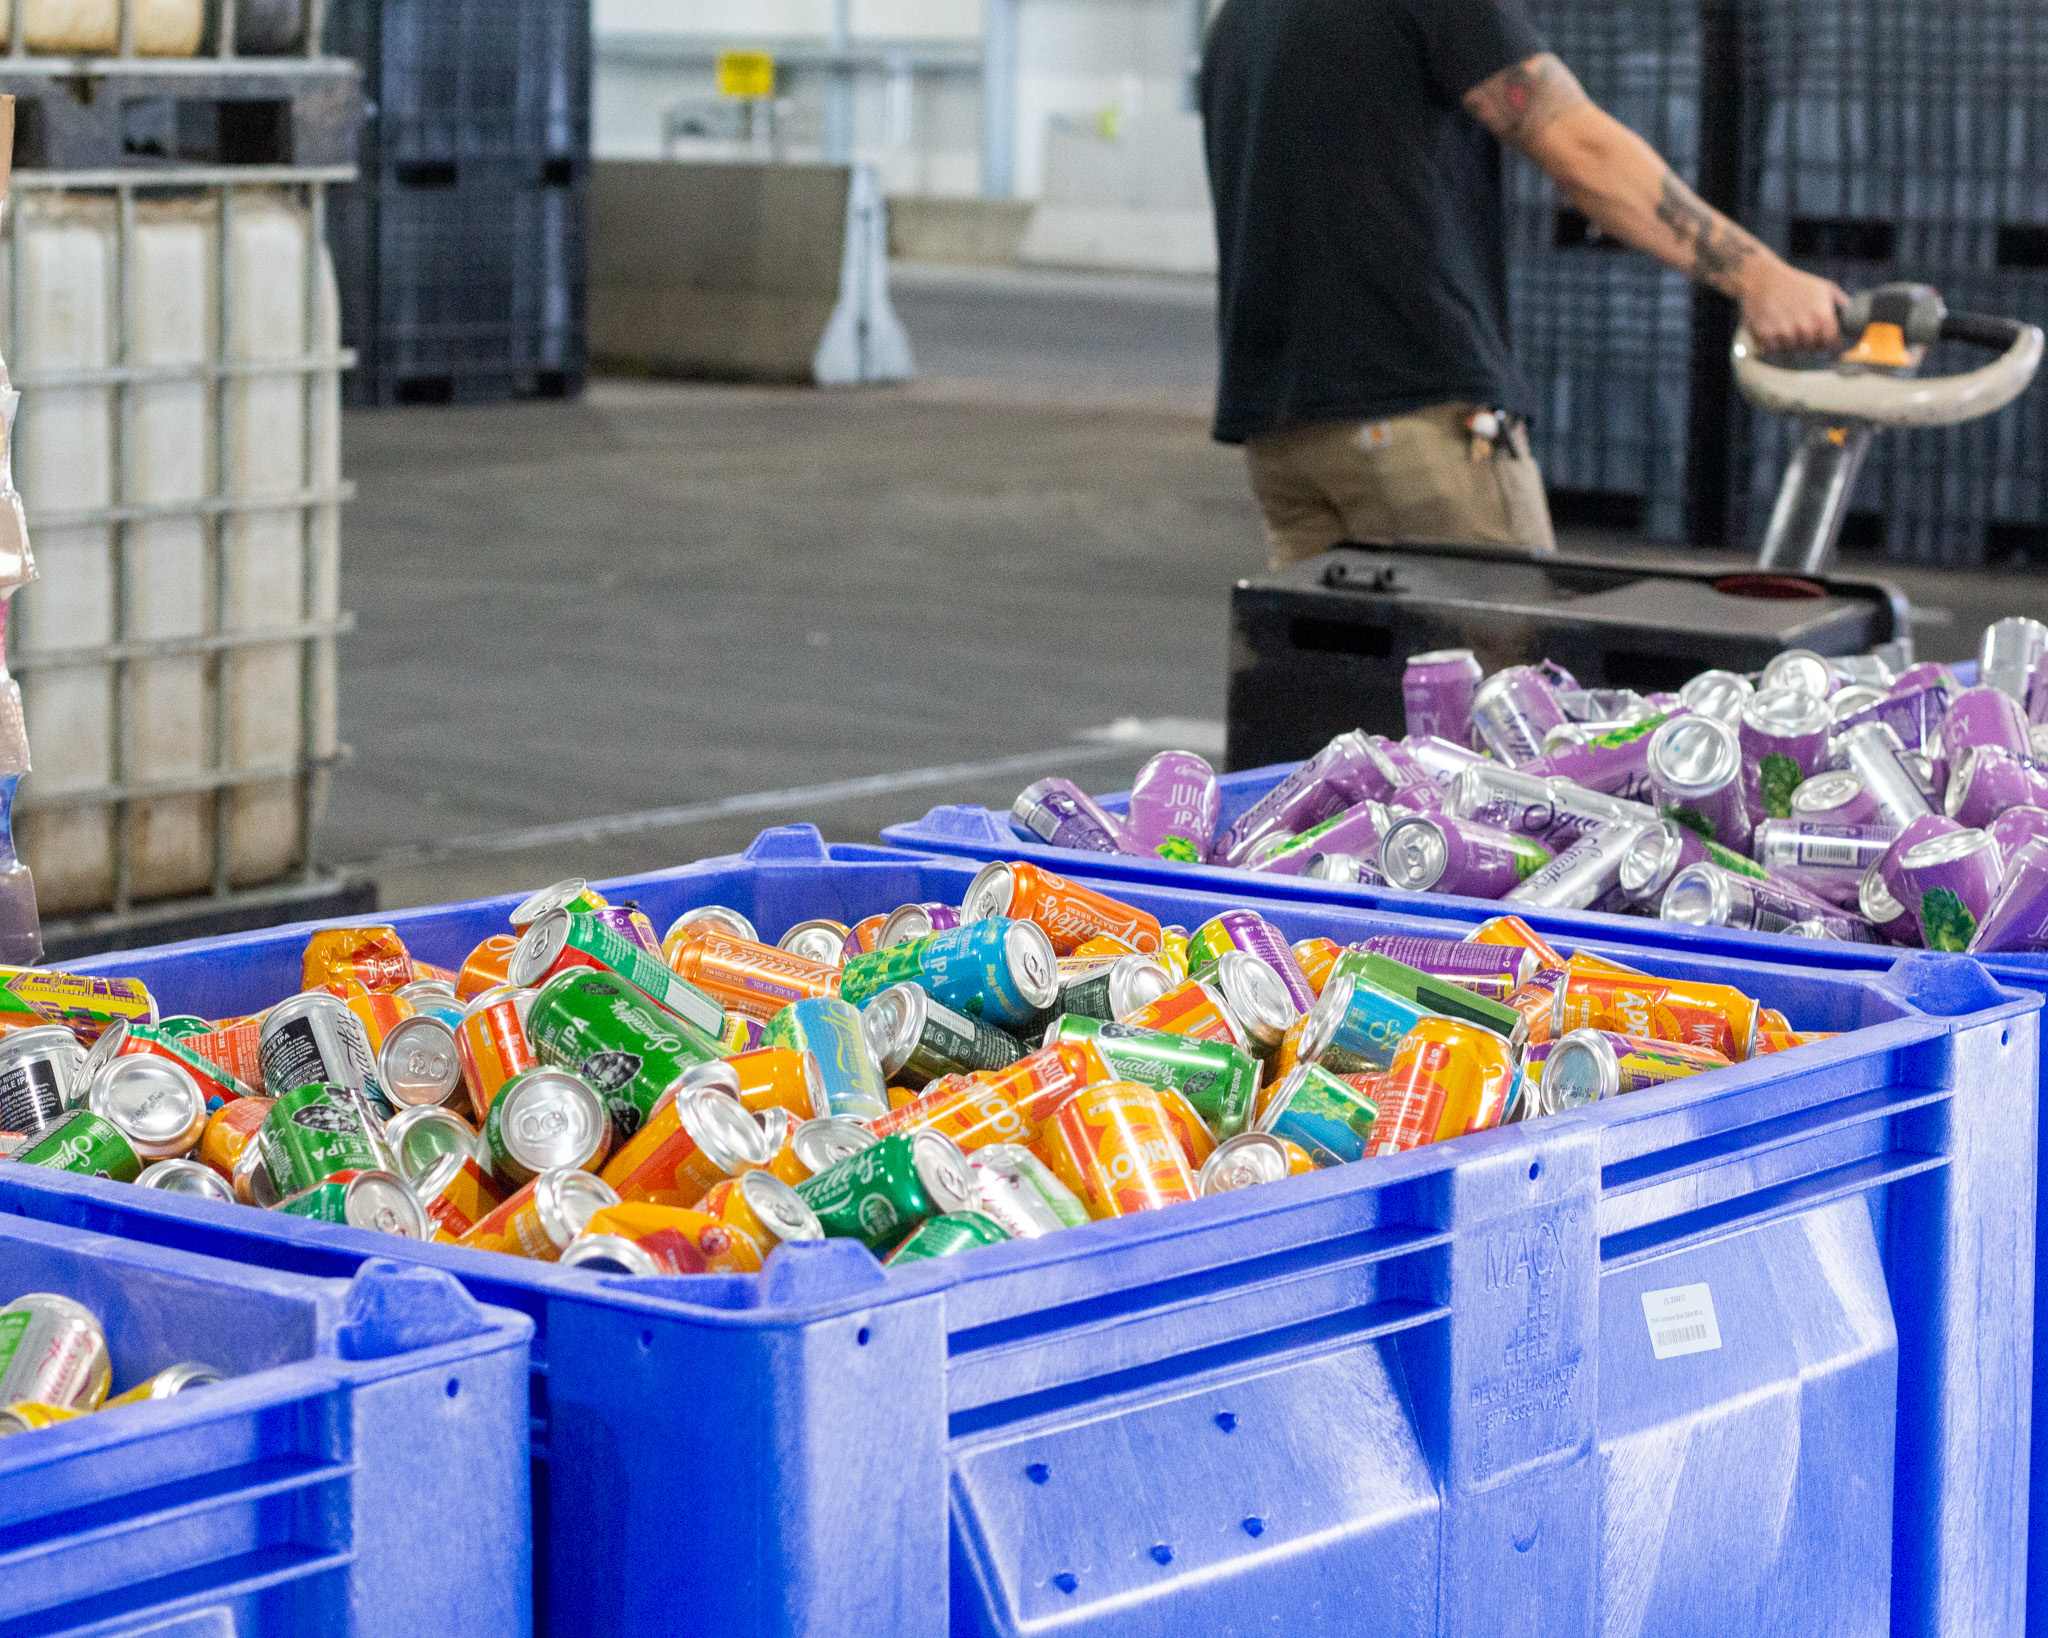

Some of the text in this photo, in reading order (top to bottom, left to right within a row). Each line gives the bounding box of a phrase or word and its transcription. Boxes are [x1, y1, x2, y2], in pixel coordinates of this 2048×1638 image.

[1174, 811, 1201, 836] IPA
[1065, 906, 1119, 931] CRAFT BEERS
[930, 956, 948, 987] IPA
[1512, 994, 1551, 1023] IPA
[277, 1032, 290, 1045] IPA
[561, 1017, 589, 1048] IPA
[609, 999, 681, 1052] Squatters
[1229, 1068, 1242, 1100] DOUBLE
[311, 1142, 346, 1161] IPA
